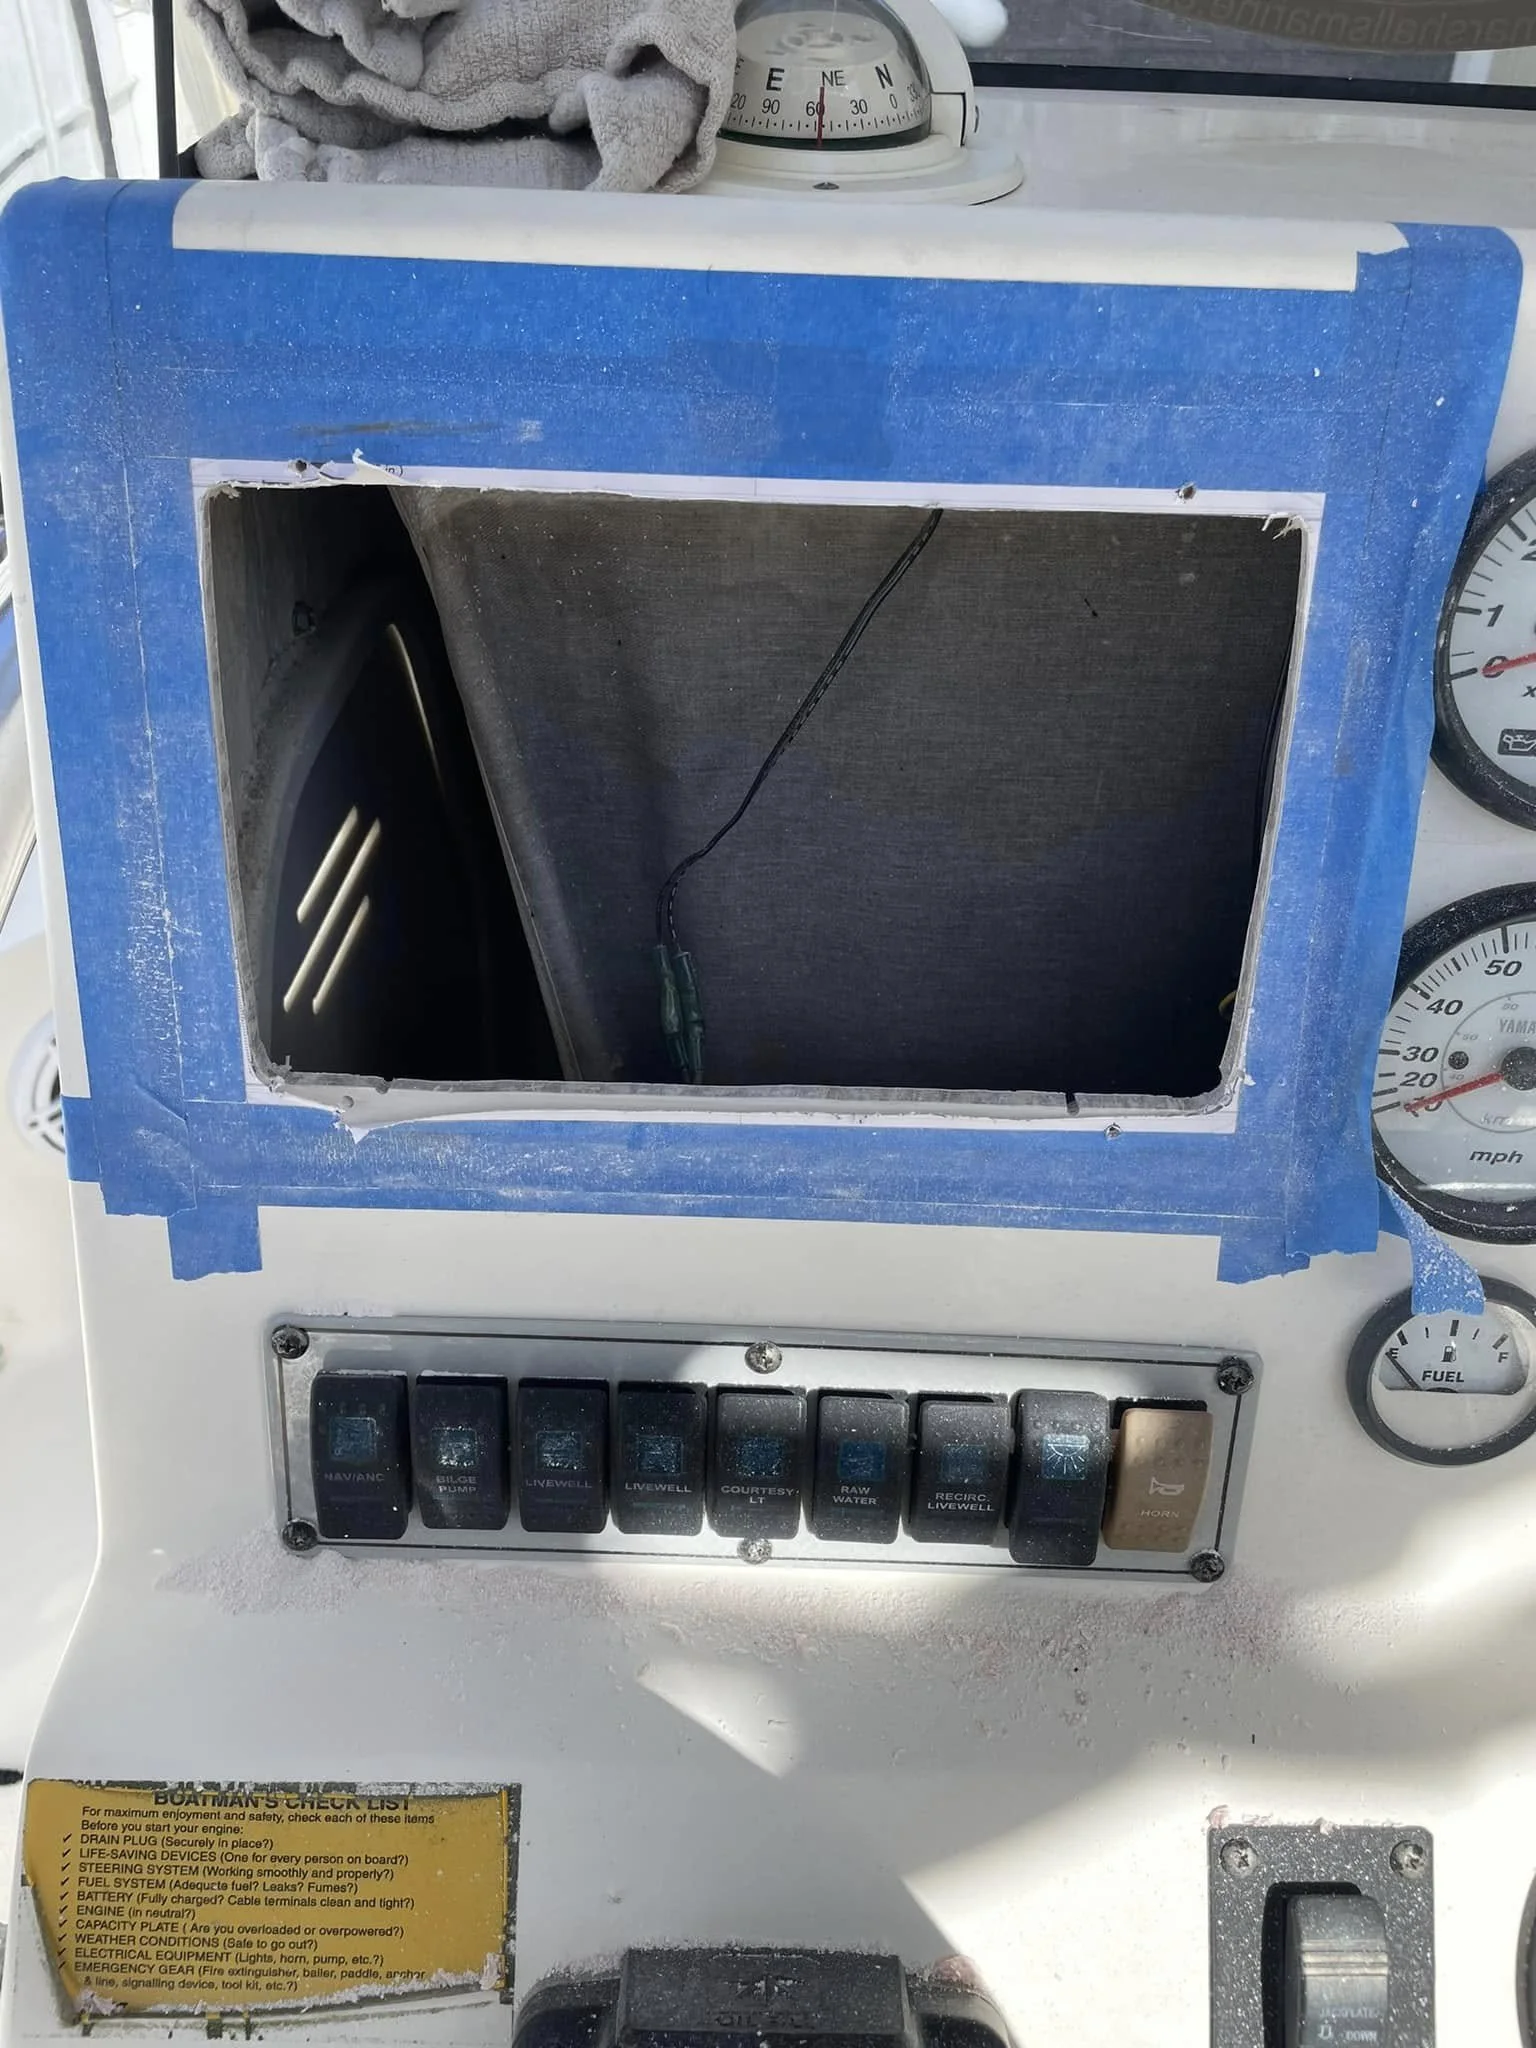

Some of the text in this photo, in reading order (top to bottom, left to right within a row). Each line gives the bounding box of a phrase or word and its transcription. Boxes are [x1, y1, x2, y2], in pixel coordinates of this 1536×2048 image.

[766, 67, 785, 91] E
[821, 70, 846, 87] NE
[875, 63, 894, 89] N
[761, 98, 780, 115] 90
[805, 101, 825, 116] 60
[851, 98, 868, 115] 30
[888, 93, 898, 109] 0
[1487, 604, 1504, 627] 1
[1482, 655, 1509, 678] 0
[1484, 959, 1522, 977] 50
[1426, 999, 1464, 1015] 40
[1401, 1046, 1439, 1063] 30
[1400, 1071, 1438, 1088] 20
[1469, 1150, 1523, 1165] mph
[1389, 1348, 1399, 1359] E
[1498, 1352, 1509, 1363] F
[1422, 1370, 1464, 1383] FUEL
[436, 1475, 478, 1484] BILGE
[526, 1479, 592, 1489] LIVEWELL
[625, 1482, 692, 1493] LIVEWELL
[438, 1485, 478, 1494] PUMP
[721, 1485, 794, 1496] COURTESY
[840, 1485, 871, 1495] RAW
[750, 1496, 765, 1504] LT
[832, 1495, 877, 1505] WATER
[927, 1502, 995, 1512] LIVEWELL
[1140, 1509, 1180, 1519] HORN
[285, 1796, 360, 1810] CHECK
[367, 1798, 410, 1811] LIST
[83, 1807, 434, 1825] For maximum enjoyment and safety, check each of these items
[81, 1820, 244, 1836] Before you start your engine:
[80, 1834, 274, 1851] DRAIN PLUG (Securely in place?)
[79, 1848, 409, 1867] LIFE-SAVING DEVICES (One for every person on board?)
[79, 1862, 394, 1881] STEERING SYSTEM (Working smoothly and properly?)
[78, 1876, 358, 1894] FUEL SYSTEM (Adequate fuel? Leaks? Fumes?)
[77, 1891, 415, 1911] BATTERY (Fully charged? Cable terminals clean and tight?)
[77, 1905, 196, 1920] ENGINE (in neutral?)
[75, 1919, 137, 1931] CAPACITY
[140, 1921, 179, 1933] PLATE
[190, 1923, 210, 1934] Are
[214, 1925, 234, 1935] you
[237, 1925, 301, 1935] overloaded
[304, 1927, 316, 1935] or
[319, 1926, 404, 1938] overpowered?)
[75, 1933, 318, 1951] WEATHER CONDITIONS (Safe to go out?)
[75, 1948, 384, 1967] ELECTRICAL EQUIPMENT (Lights, horn, pump, etc.?)
[75, 1962, 155, 1974] EMERGENCY
[158, 1964, 195, 1975] GEAR
[198, 1966, 224, 1977] (Fire
[227, 1967, 300, 1979] extinguisher,
[303, 1968, 337, 1979] bailer,
[341, 1969, 382, 1980] paddle,
[84, 1976, 298, 1993] & line, signalling device, tool kit, etc.?)
